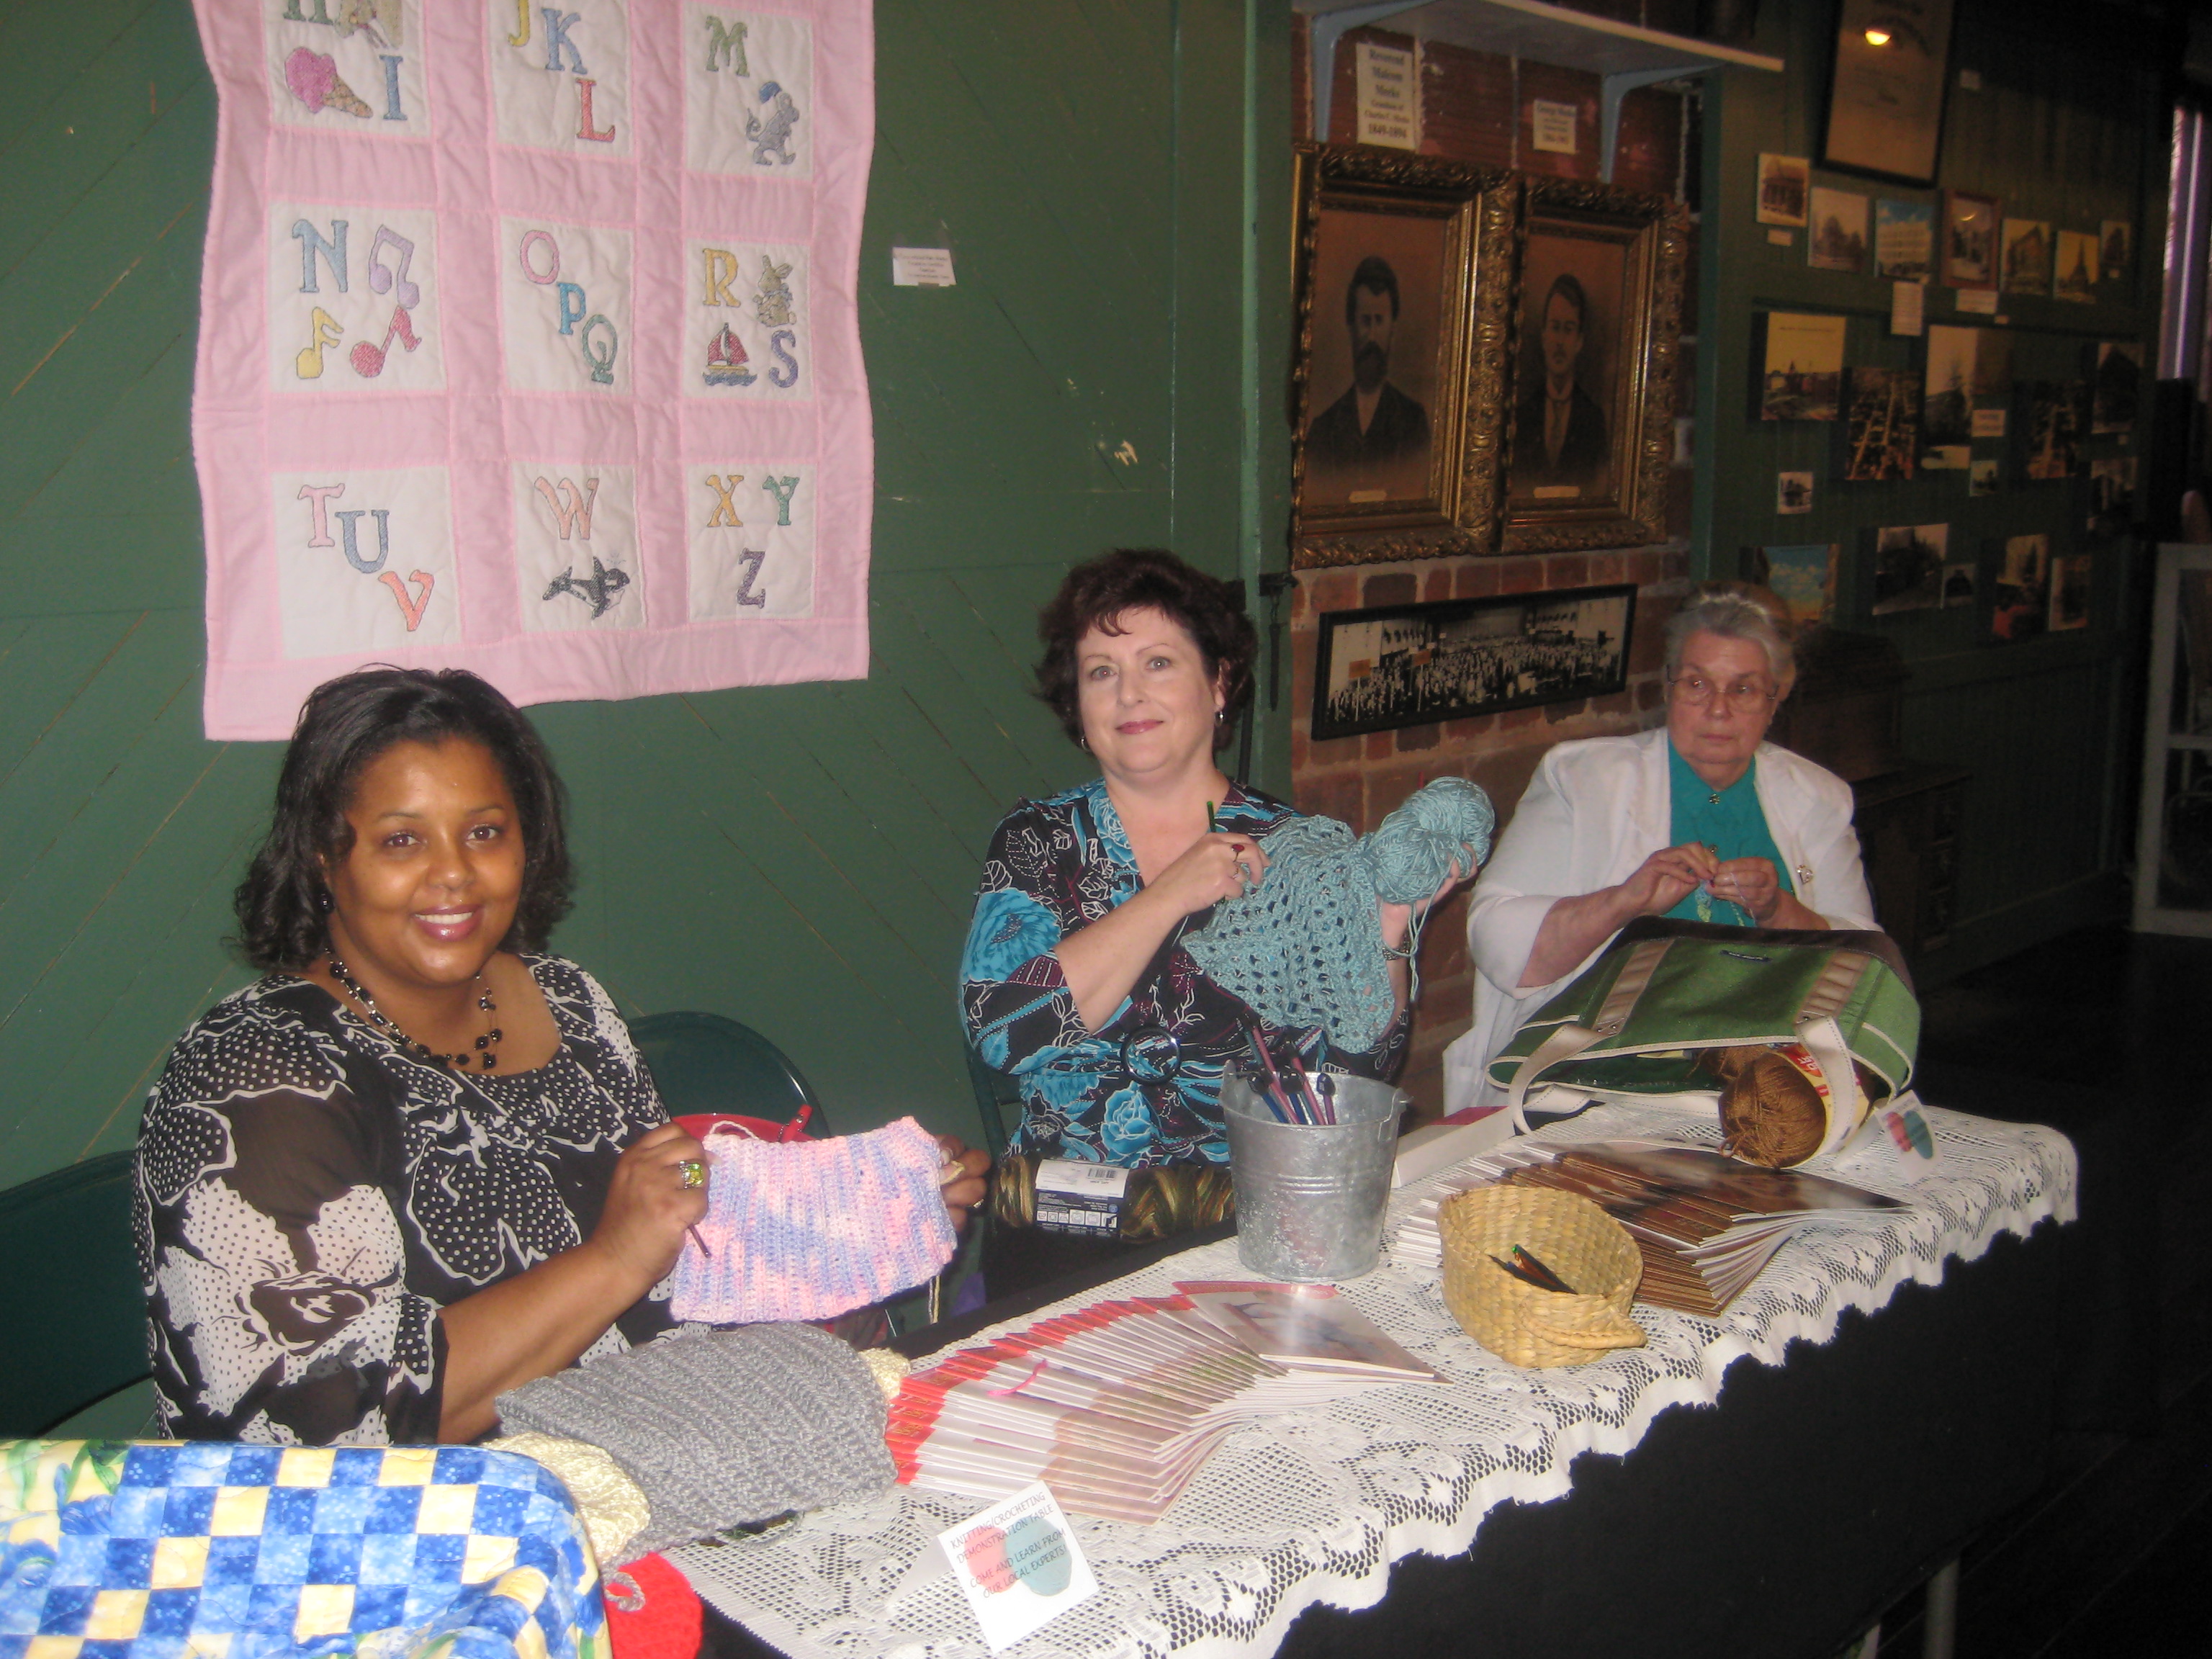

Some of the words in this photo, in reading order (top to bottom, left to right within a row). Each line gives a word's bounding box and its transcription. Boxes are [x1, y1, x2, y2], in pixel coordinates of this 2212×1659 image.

[544, 8, 587, 74] K
[705, 15, 750, 78] M
[379, 55, 408, 121] I
[576, 78, 616, 143] L
[292, 219, 349, 293] N
[518, 229, 560, 285] O
[702, 248, 741, 308] R
[557, 282, 586, 336] P
[581, 313, 618, 385] Q
[768, 329, 799, 389] S
[297, 482, 346, 548] T
[534, 476, 600, 541] W
[706, 474, 745, 528] X
[762, 475, 801, 527] Y
[334, 509, 390, 574] U
[379, 569, 435, 632] V
[737, 548, 767, 609] Z
[950, 1492, 1046, 1549] KNITTING/CROCHETING
[956, 1519, 1028, 1563] DEMONSTRATION
[1030, 1503, 1054, 1524] TABLE
[970, 1568, 994, 1588] COME
[997, 1557, 1014, 1574] AND
[1015, 1542, 1041, 1563] LEARN
[1042, 1528, 1066, 1547] FROM
[984, 1581, 1002, 1599] OUR
[1004, 1566, 1030, 1586] LOCAL
